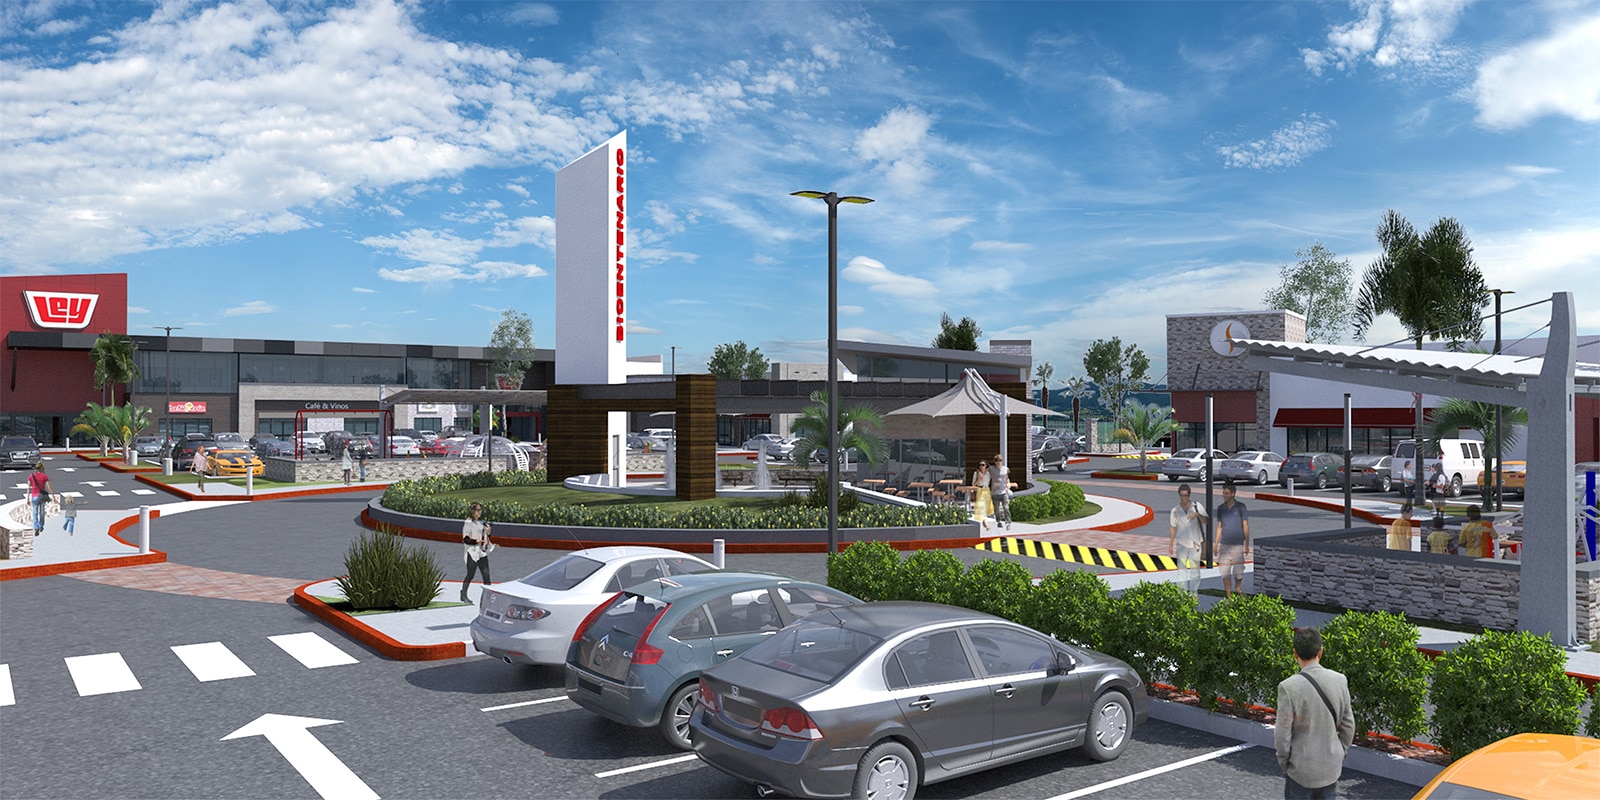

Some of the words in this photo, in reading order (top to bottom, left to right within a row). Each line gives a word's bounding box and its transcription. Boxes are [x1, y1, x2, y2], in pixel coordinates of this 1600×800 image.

[616, 148, 624, 341] BICENTENARIO
[305, 402, 321, 410] Café
[322, 402, 329, 410] &
[329, 402, 349, 410] Vinos
